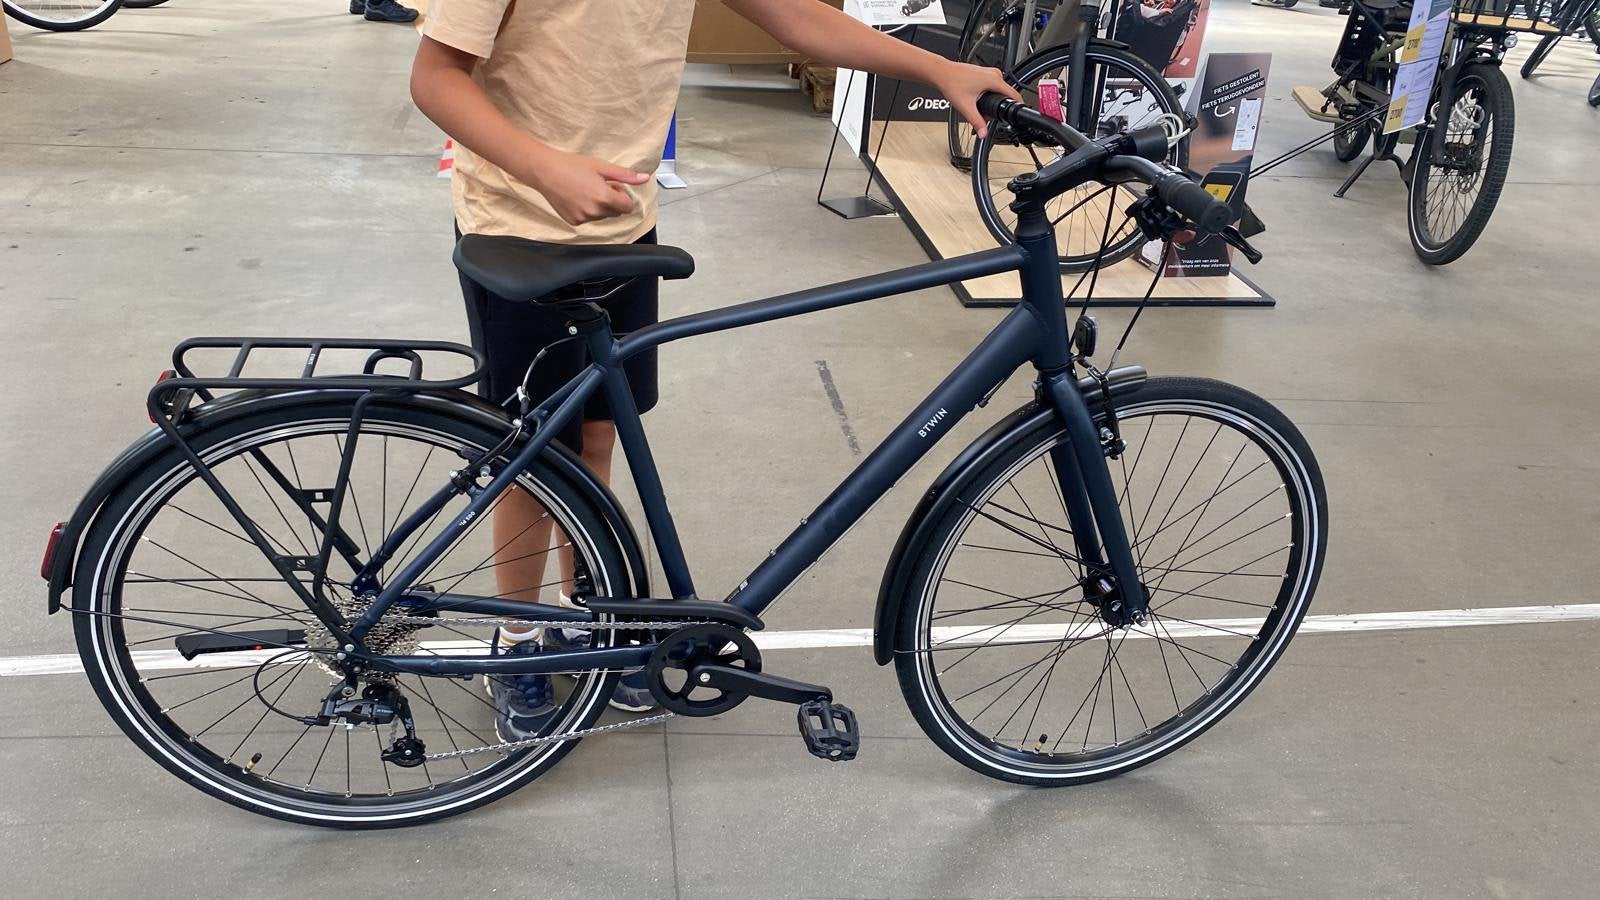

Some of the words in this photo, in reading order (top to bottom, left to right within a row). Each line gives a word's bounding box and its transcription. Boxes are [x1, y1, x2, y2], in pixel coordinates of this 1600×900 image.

[1213, 84, 1229, 94] FIETS
[1201, 100, 1218, 110] FIETS
[918, 407, 948, 438] BTWIN
